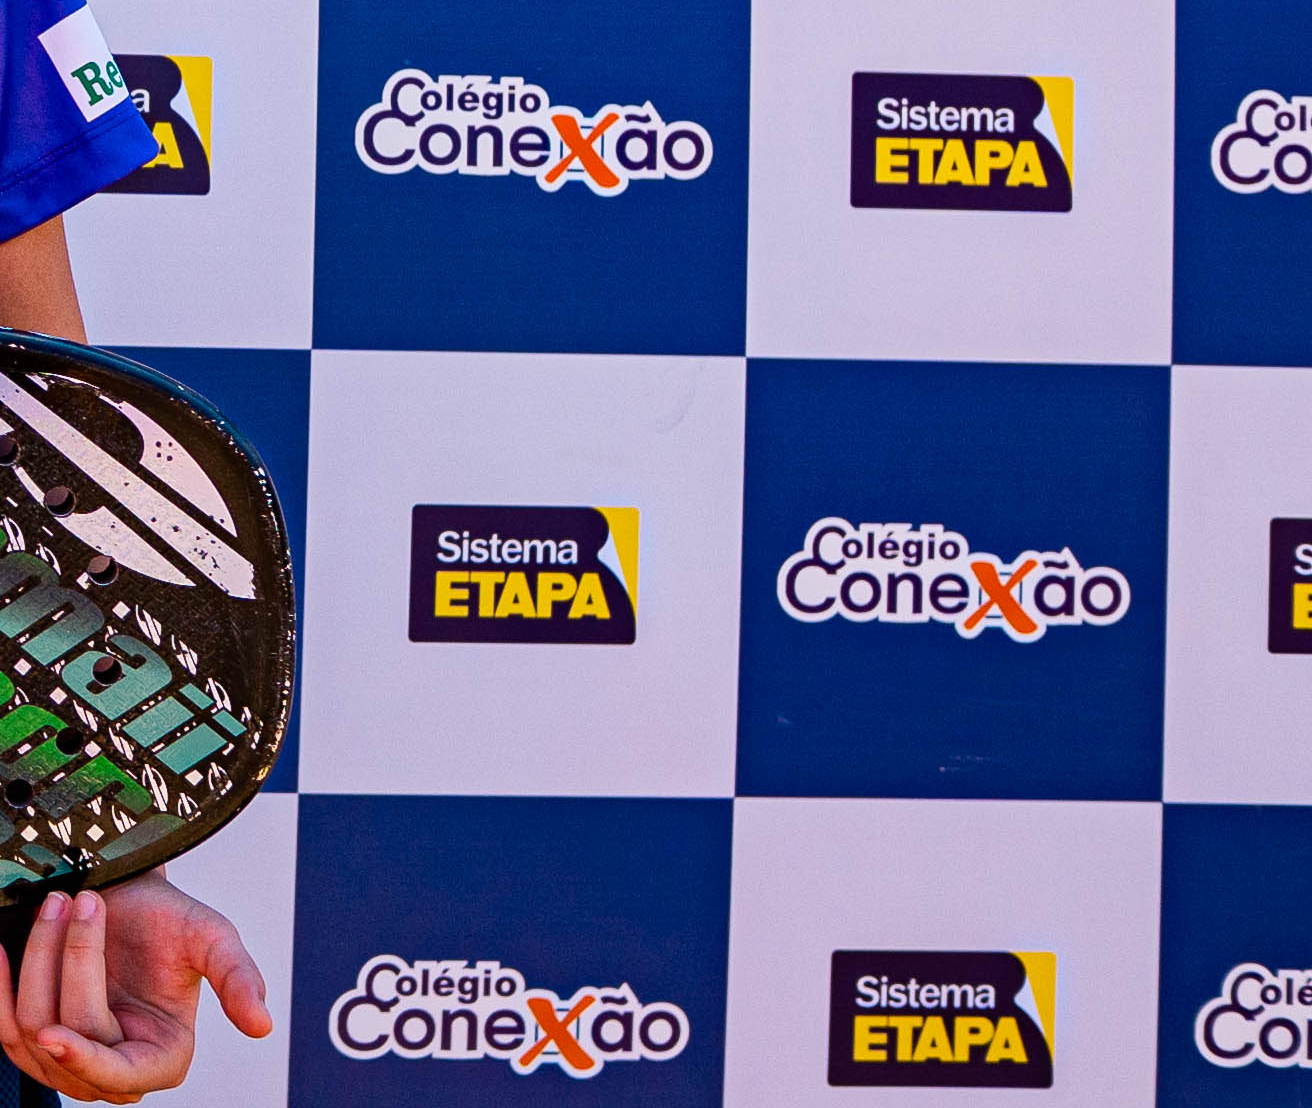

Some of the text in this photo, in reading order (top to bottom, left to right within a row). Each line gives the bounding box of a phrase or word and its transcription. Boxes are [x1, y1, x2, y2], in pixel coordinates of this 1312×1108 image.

[391, 76, 541, 117] Colégio
[876, 97, 1014, 133] Sistema
[875, 138, 1046, 188] ETAPA
[436, 531, 578, 566] Sistema
[812, 524, 960, 566] Colégio
[435, 570, 609, 620] ETAPA
[365, 961, 516, 1002] Colégio
[855, 976, 994, 1009] Sistema
[1231, 972, 1312, 1017] Colé
[853, 1015, 1027, 1065] ETAPA
